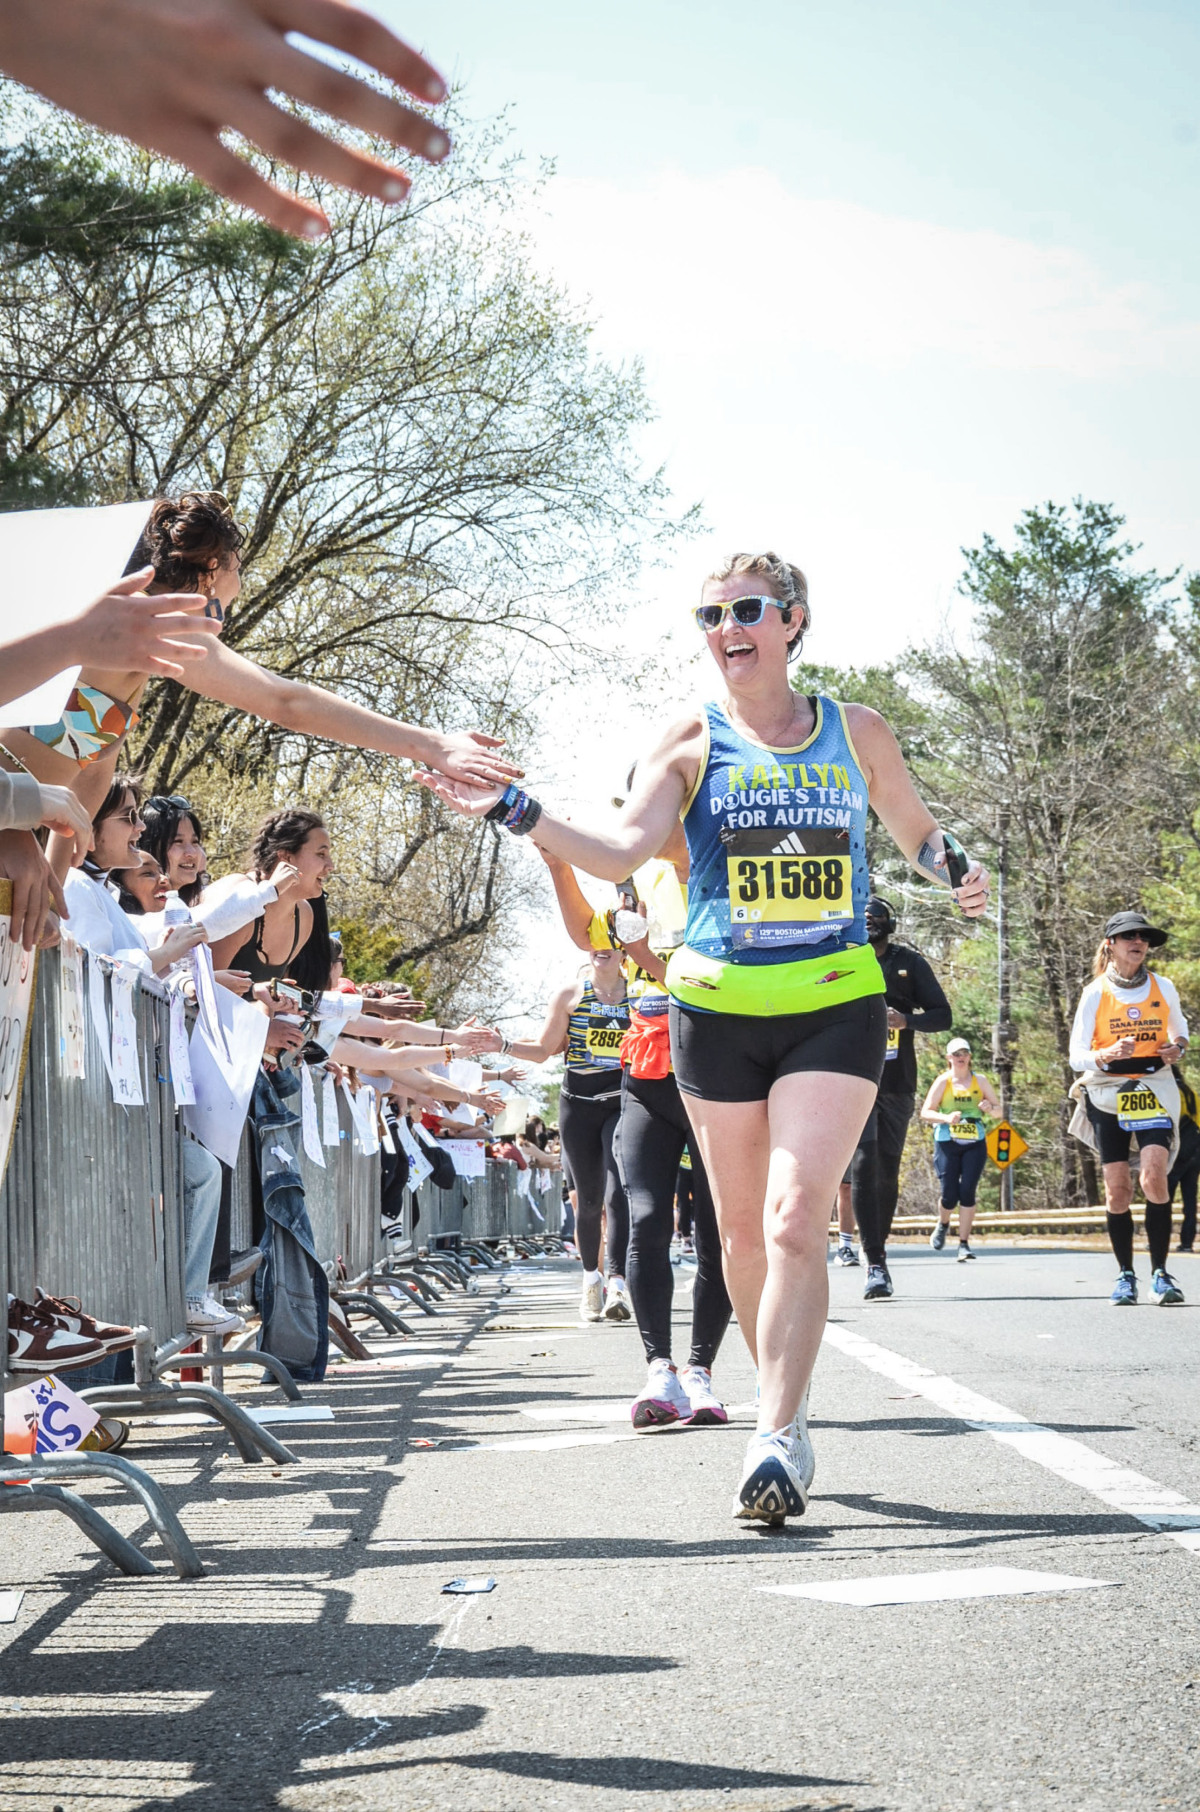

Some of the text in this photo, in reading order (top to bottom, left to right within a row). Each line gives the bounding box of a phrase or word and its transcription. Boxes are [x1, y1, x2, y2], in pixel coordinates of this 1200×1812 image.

[728, 763, 851, 792] KAITLYN
[710, 787, 863, 815] DOUGIE'S TEAM
[727, 808, 851, 829] FOR AUTISM
[738, 859, 843, 902] 31588
[736, 909, 744, 918] 6
[775, 928, 802, 936] BOSTON
[804, 924, 843, 934] MARATHON
[1121, 1092, 1163, 1111] 2603
